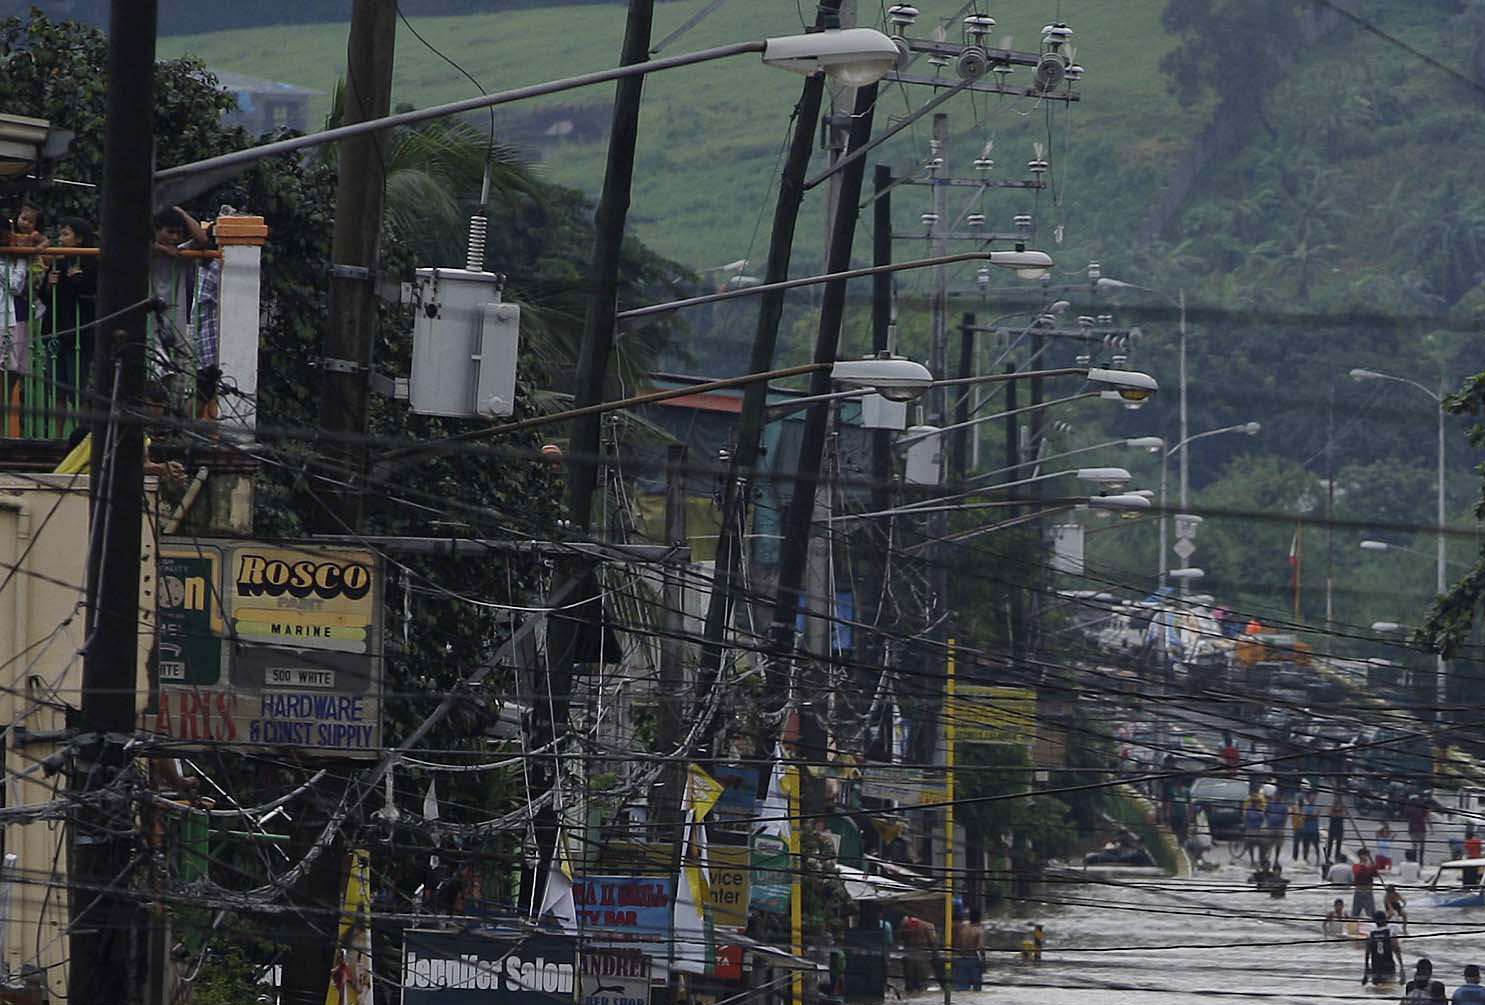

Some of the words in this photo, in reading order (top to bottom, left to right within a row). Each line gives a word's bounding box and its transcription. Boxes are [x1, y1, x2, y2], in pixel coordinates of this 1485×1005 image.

[238, 555, 370, 600] ROSCO
[271, 624, 331, 638] MARINE
[272, 670, 291, 682] 500
[299, 672, 331, 684] WHITE
[261, 694, 364, 721] HARDWARE
[318, 725, 374, 747] SUPPLY
[405, 952, 502, 991] Jennifer
[506, 956, 574, 993] Salon
